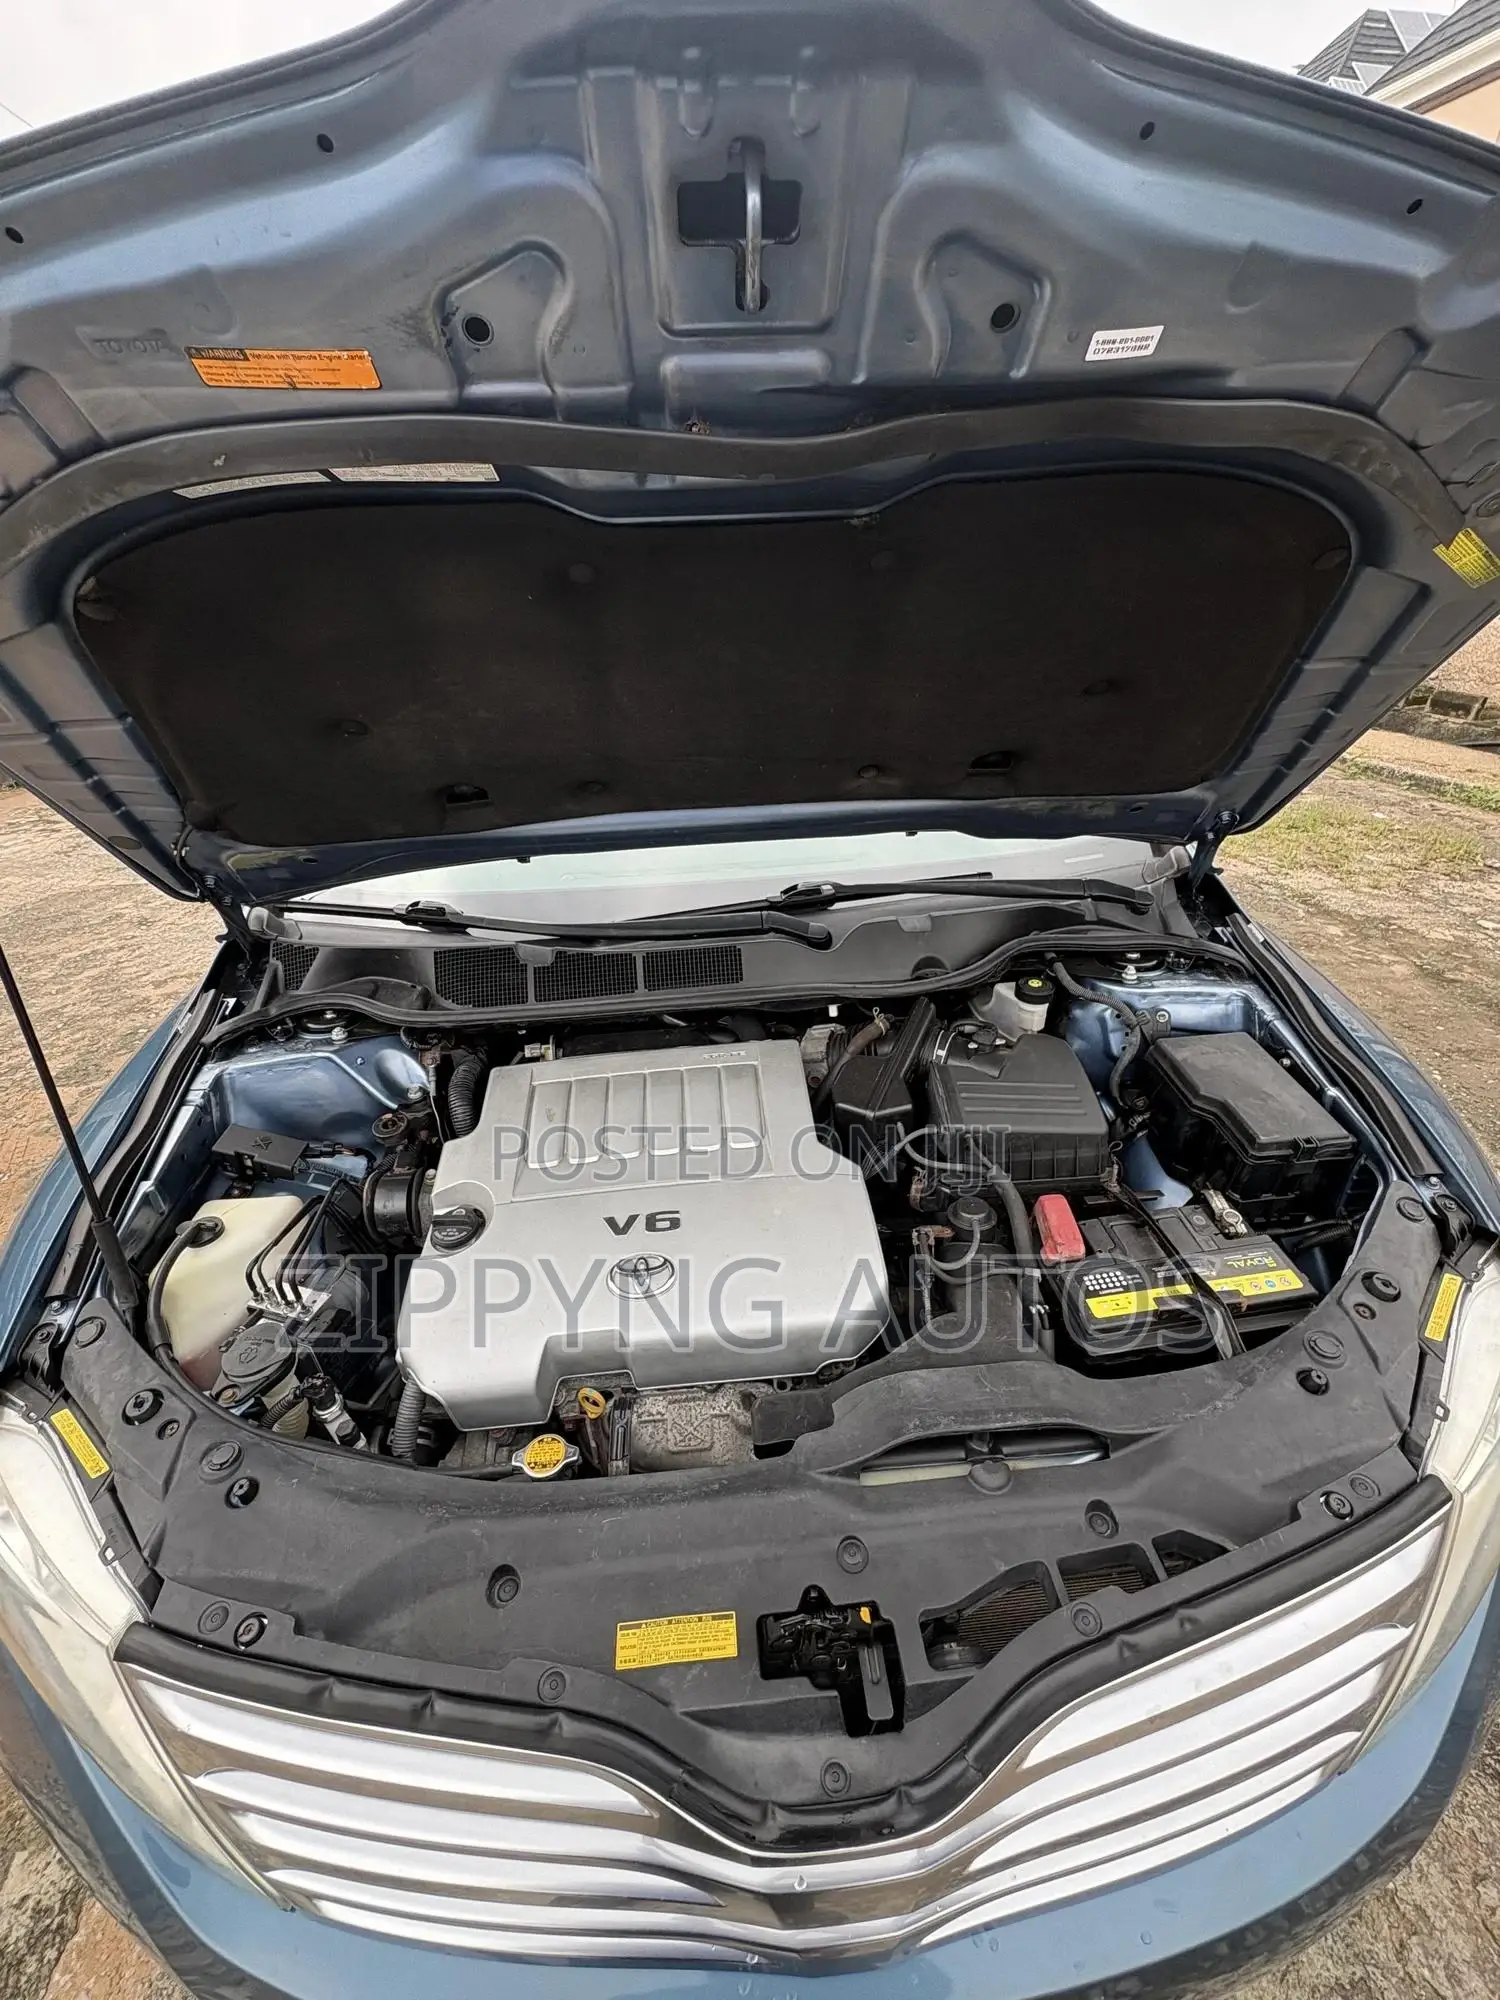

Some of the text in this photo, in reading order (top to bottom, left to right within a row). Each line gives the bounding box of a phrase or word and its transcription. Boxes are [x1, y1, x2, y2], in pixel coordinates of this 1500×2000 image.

[203, 349, 244, 360] WARNING
[249, 352, 275, 360] Vehicle
[318, 354, 341, 362] Engine
[603, 1210, 681, 1236] V6
